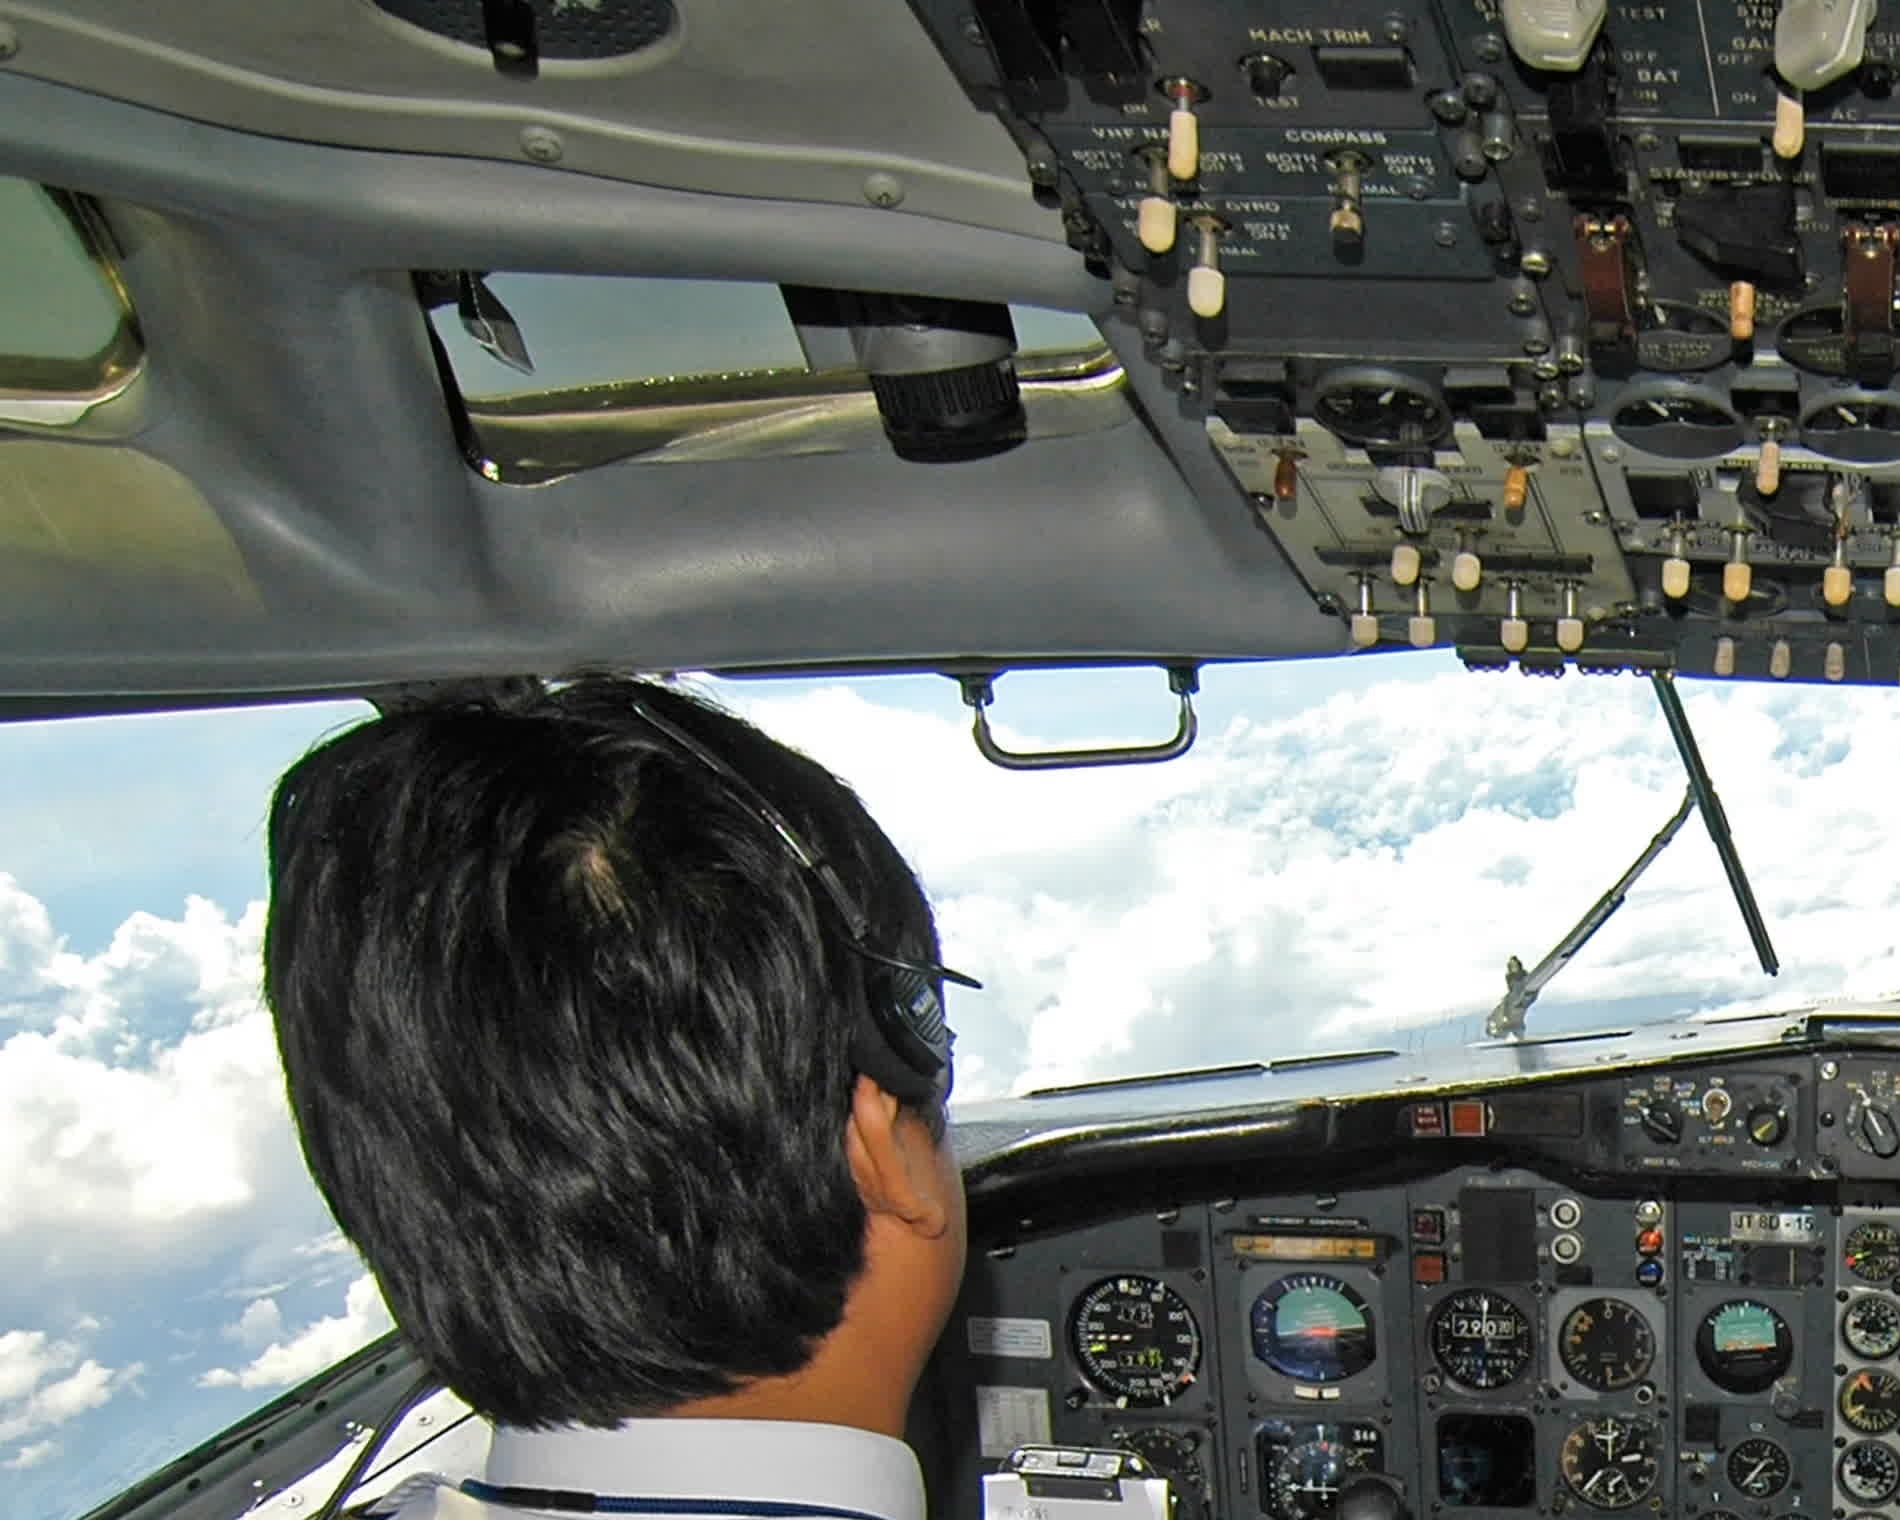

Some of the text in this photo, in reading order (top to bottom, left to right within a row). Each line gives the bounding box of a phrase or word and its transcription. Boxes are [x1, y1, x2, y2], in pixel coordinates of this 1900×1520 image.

[1249, 28, 1372, 44] MACH TRIM
[1284, 129, 1388, 145] COMPASS
[1198, 151, 1242, 162] OTH
